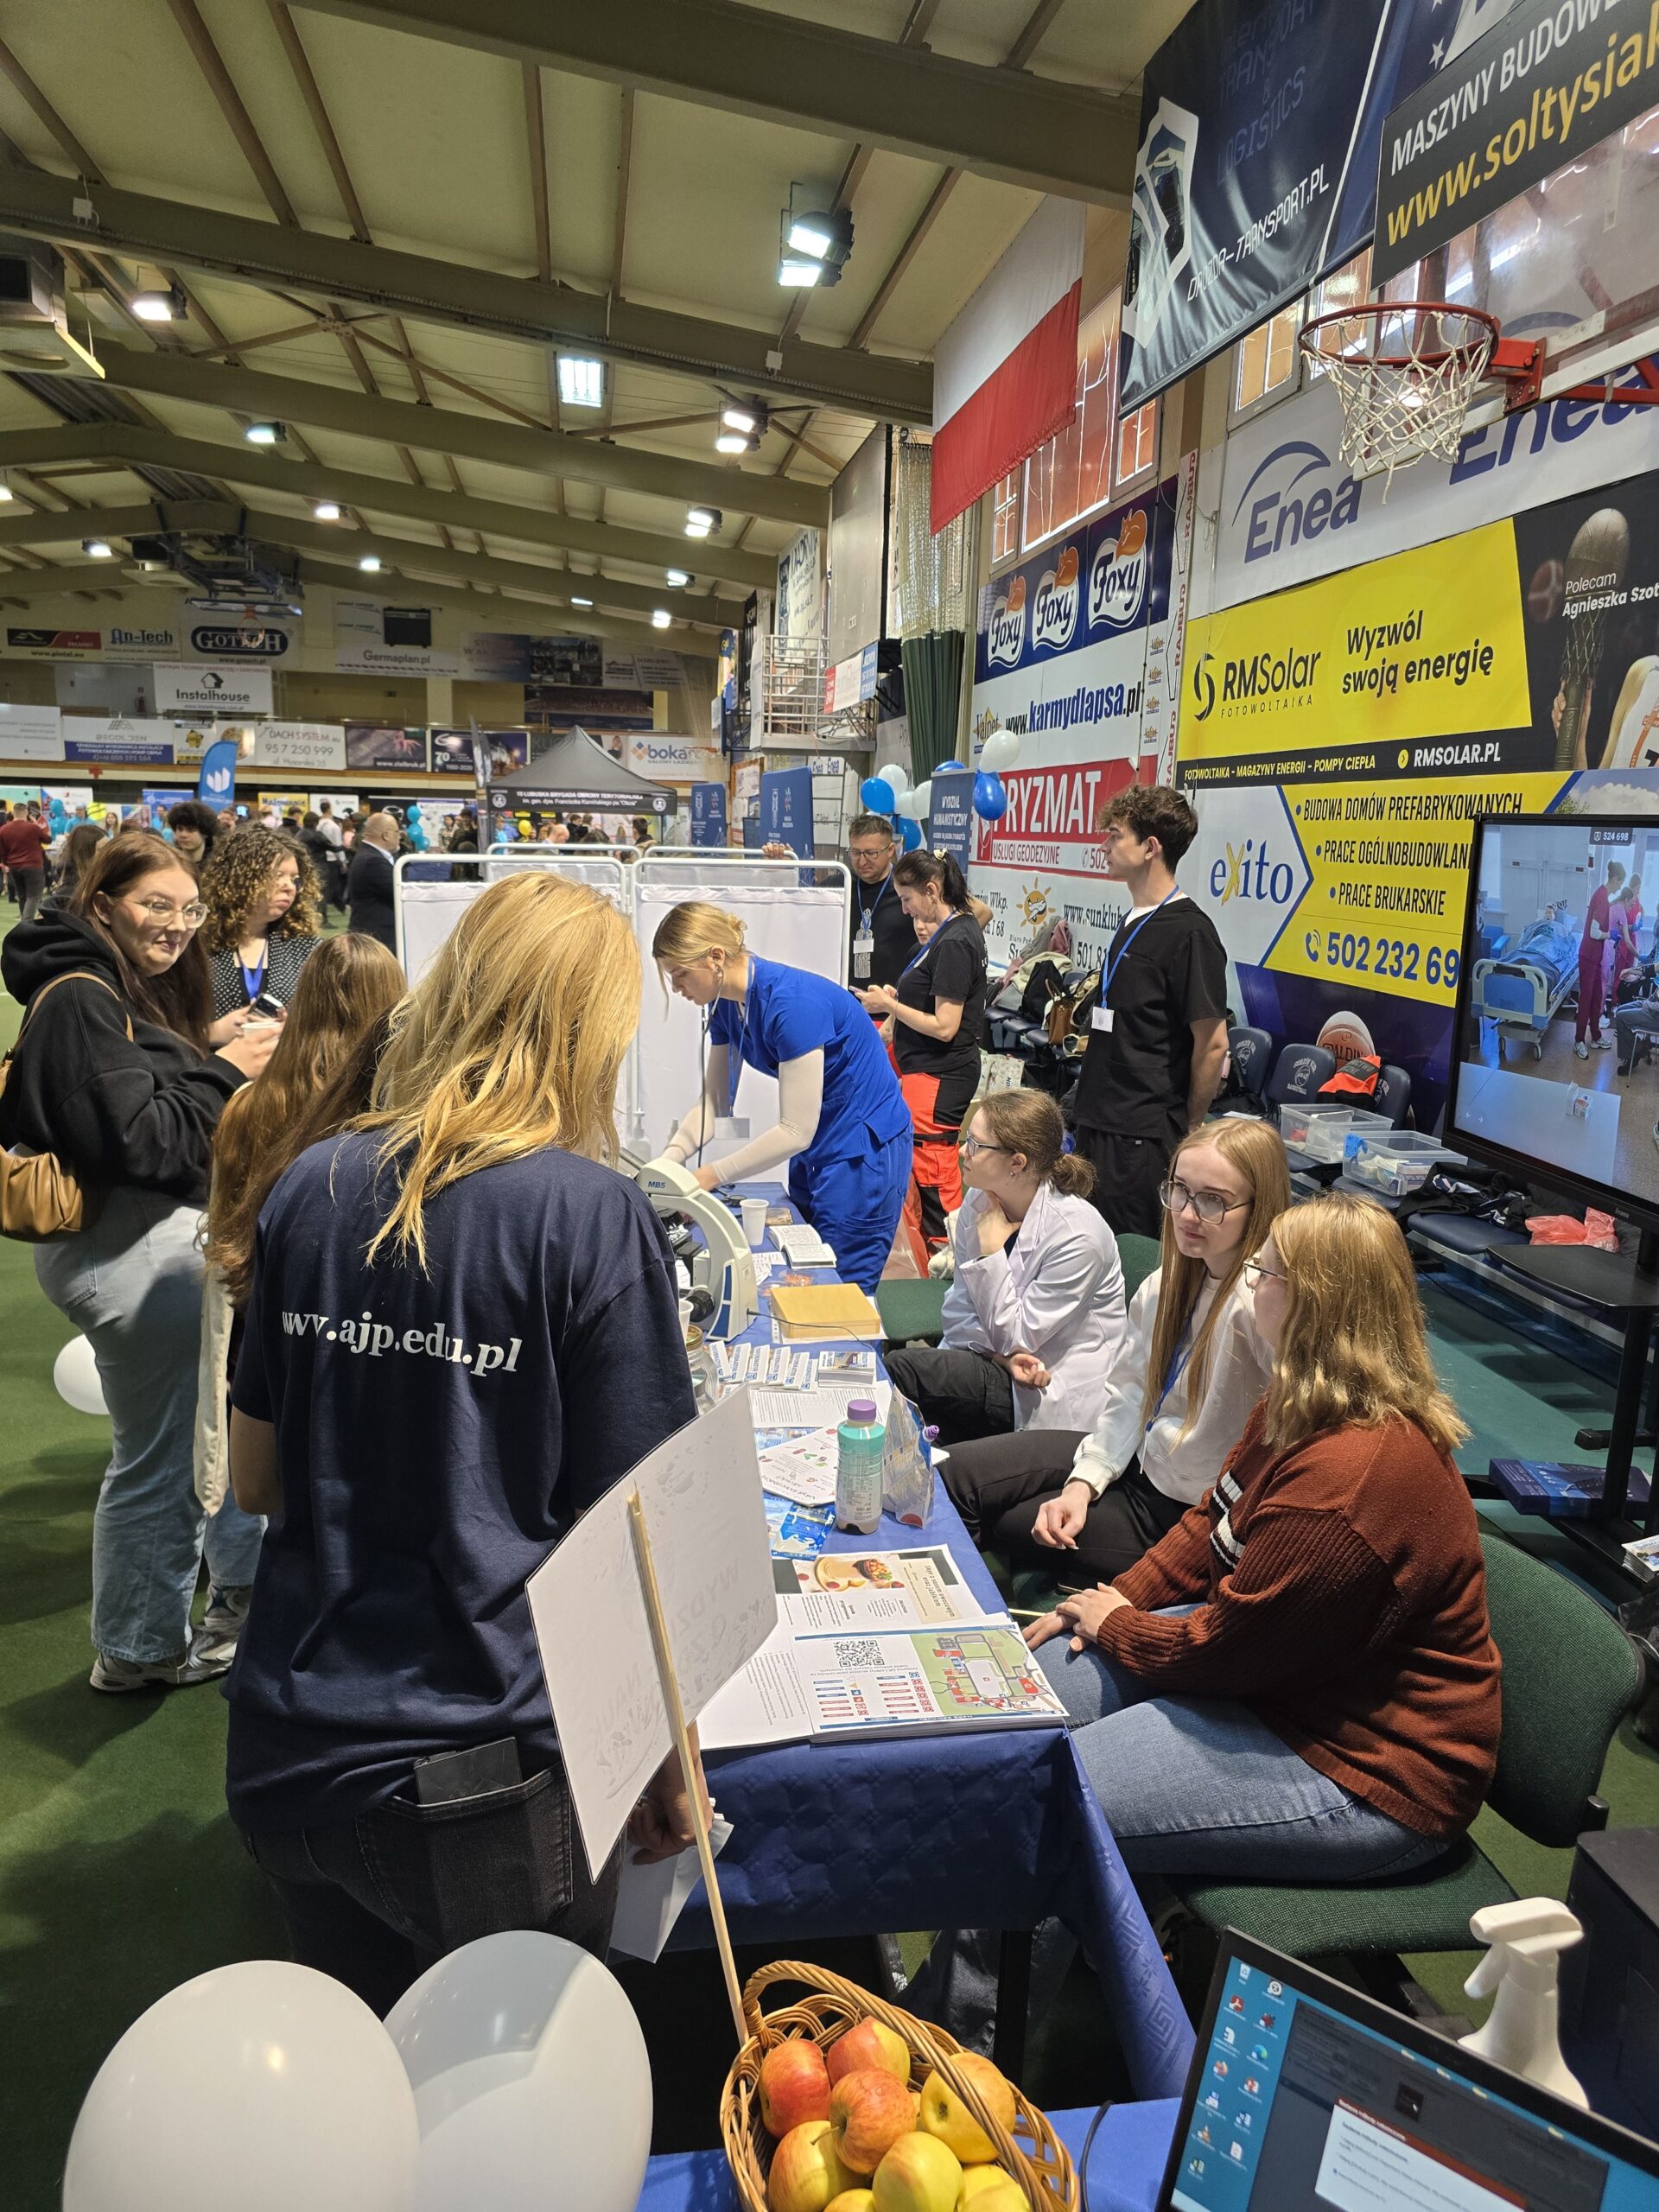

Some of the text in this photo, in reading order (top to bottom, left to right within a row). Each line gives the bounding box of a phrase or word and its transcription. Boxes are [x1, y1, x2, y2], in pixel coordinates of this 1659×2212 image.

[1217, 66, 1306, 188] LOGISTICS
[1391, 60, 1496, 176] MASZYNY
[1187, 163, 1329, 302] DROZDA-TRANSPORT.PL
[1185, 452, 1196, 538] RAJBUD
[1244, 479, 1363, 563] Enea
[1093, 552, 1141, 613] Foxy
[1566, 573, 1617, 595] Polecam
[1037, 583, 1074, 637] Foxy
[1562, 591, 1627, 620] Agnieszka
[991, 608, 1022, 656] Foxy
[1175, 583, 1185, 666] RAJBUD
[1346, 609, 1424, 661] Wyzwól
[363, 650, 430, 664] Germaplan.pl
[1342, 639, 1495, 698] swoją energię
[1223, 647, 1321, 702] RMSolar
[176, 690, 251, 702] Instalhouse
[1006, 681, 1141, 735] www.karmydlapsa.pl
[1220, 694, 1314, 719] FOTOWOLTAIKA
[435, 752, 449, 761] 70
[648, 745, 702, 760] boka
[828, 758, 839, 774] Enea
[1185, 754, 1376, 781] FOTOWOLTAIKA MAGAZYNY ENERGII POMPY CIEPŁA
[1413, 741, 1502, 767] RMSOLAR.PL
[1303, 790, 1522, 822] BUDOWA DOMÓW PREFABRYKOWANYCH
[994, 842, 1015, 861] USŁUGI
[1017, 843, 1060, 864] GEODEZYJNE
[1324, 835, 1473, 870] PRACE OGÓLNOBUDOWLAN
[1603, 832, 1615, 841] 524
[990, 892, 1008, 913] Wlkp.
[1338, 882, 1446, 917] PRACE BRUKARSKIE
[1009, 934, 1022, 944] Biuro
[1077, 942, 1093, 970] 501
[1327, 932, 1459, 989] 502 232 69
